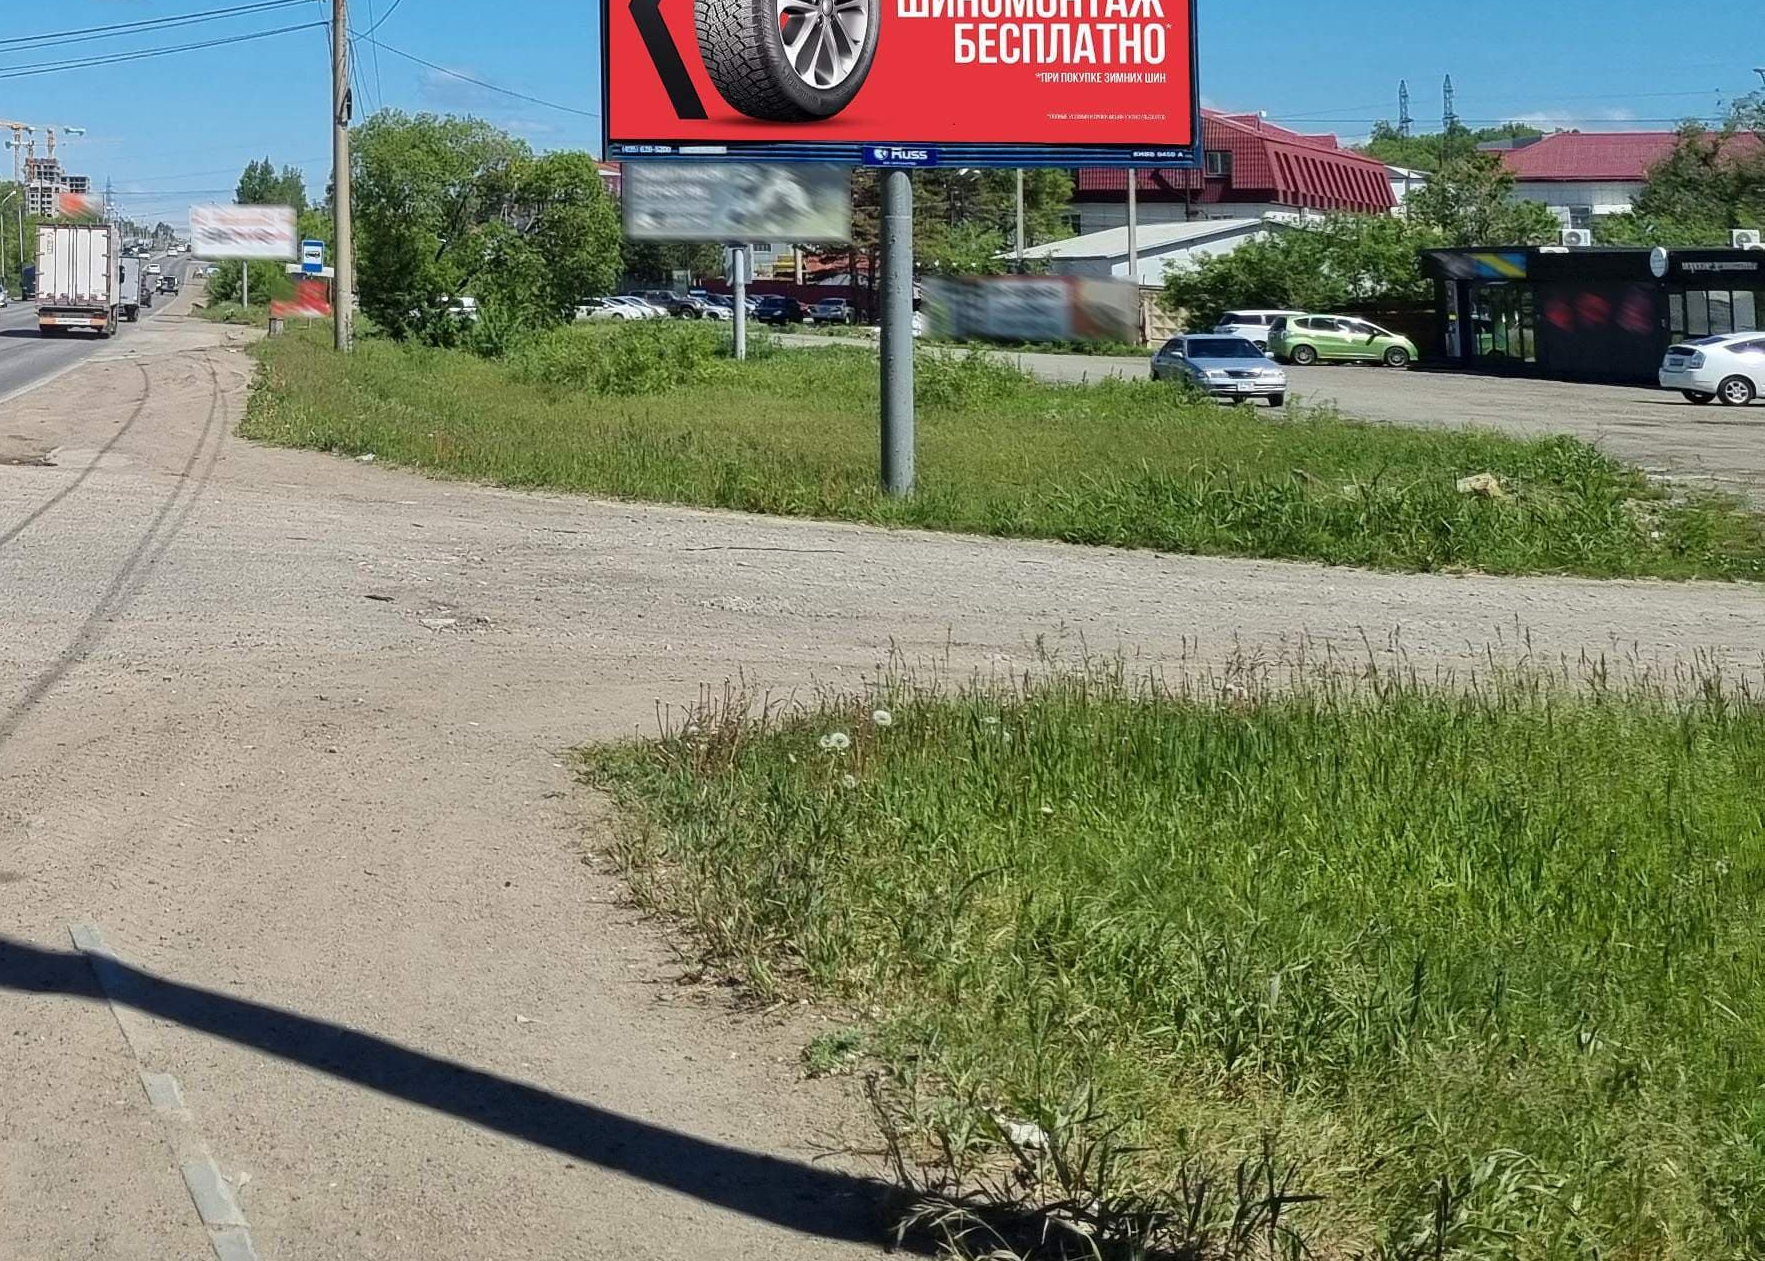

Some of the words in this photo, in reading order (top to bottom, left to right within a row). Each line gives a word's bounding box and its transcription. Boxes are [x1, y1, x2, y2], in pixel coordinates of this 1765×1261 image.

[1061, 72, 1102, 83] ПОКУПКЕ
[1104, 72, 1143, 84] ЗИМНИХ
[1145, 73, 1166, 84] ШИН
